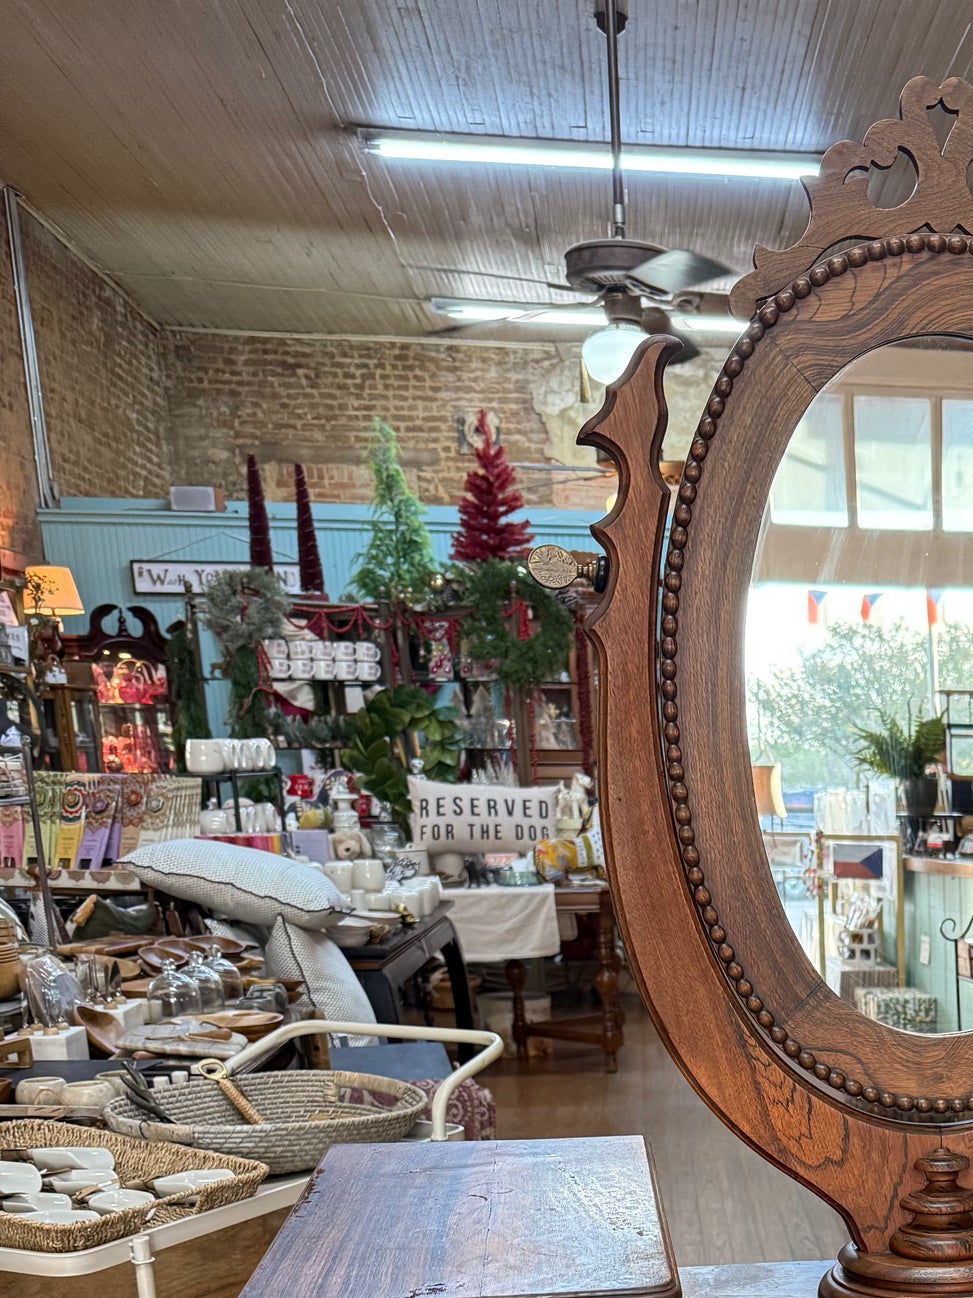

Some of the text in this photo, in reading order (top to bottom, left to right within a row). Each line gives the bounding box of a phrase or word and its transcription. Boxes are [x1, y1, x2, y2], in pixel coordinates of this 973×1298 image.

[420, 796, 549, 819] RESERVED
[420, 824, 549, 841] FOR THE DOG
